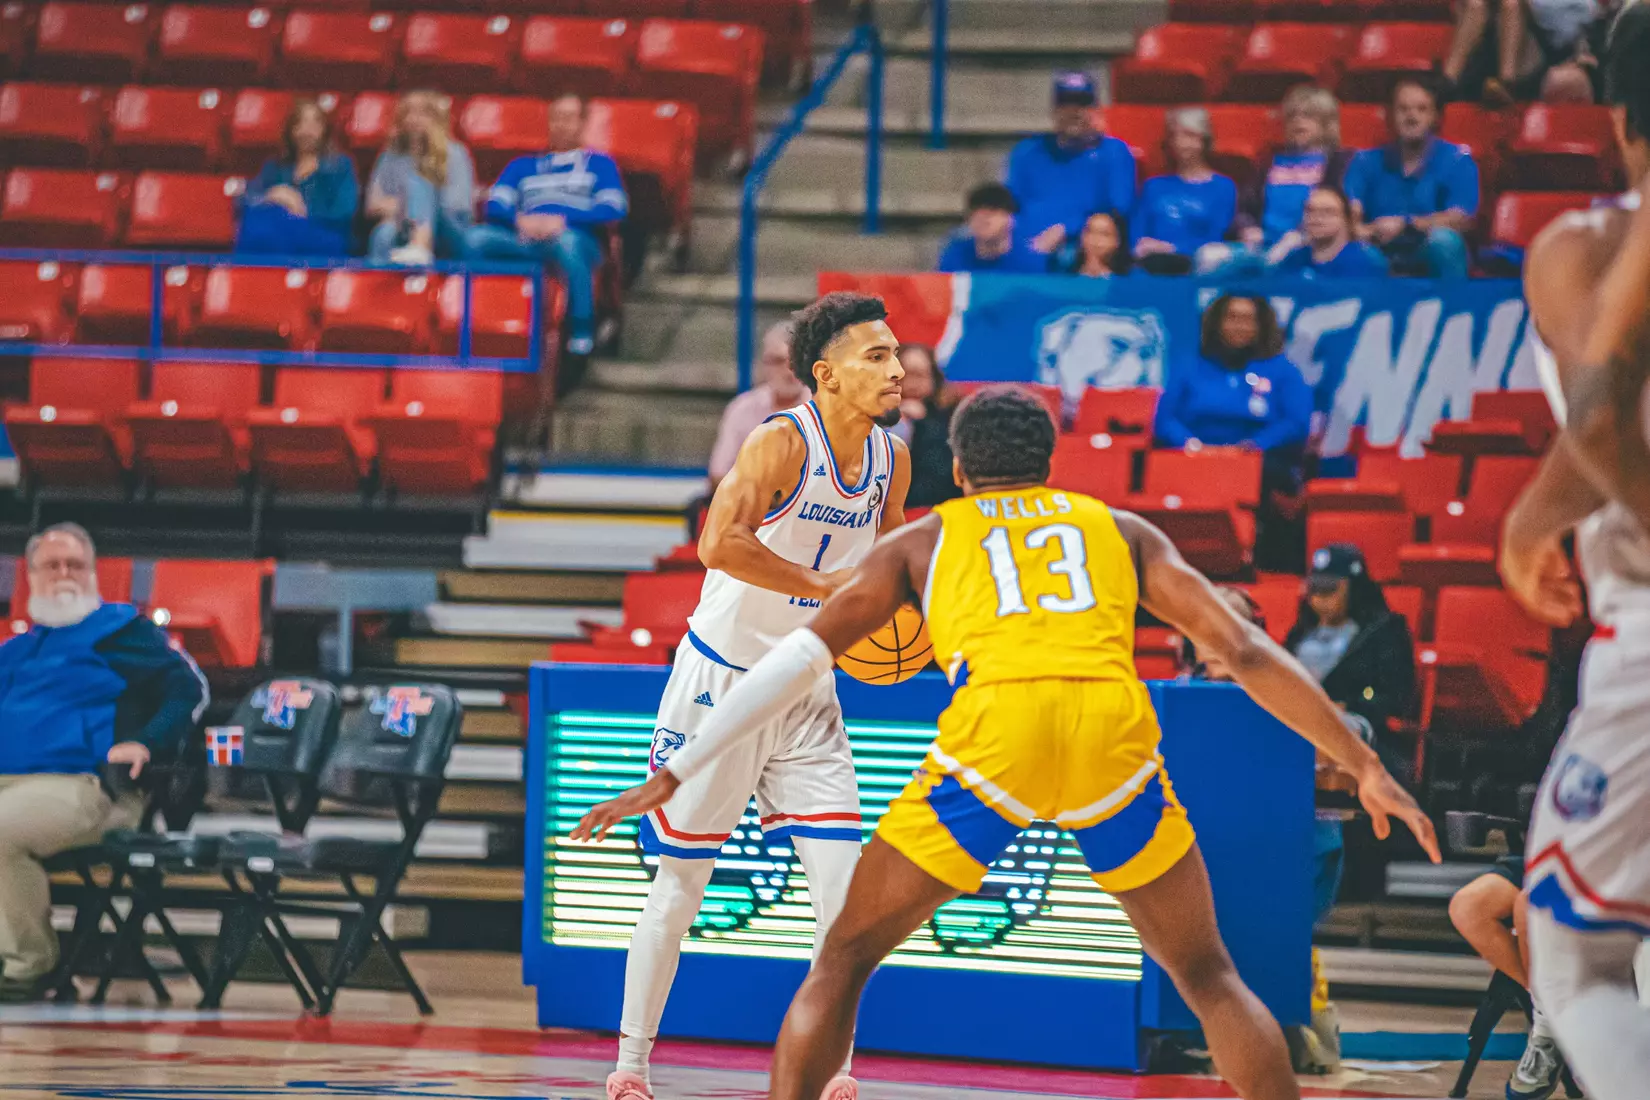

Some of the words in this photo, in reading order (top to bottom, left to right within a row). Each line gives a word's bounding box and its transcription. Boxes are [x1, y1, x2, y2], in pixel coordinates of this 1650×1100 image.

[974, 492, 1073, 520] WELLS
[811, 533, 832, 572] 1
[980, 523, 1097, 617] 13
